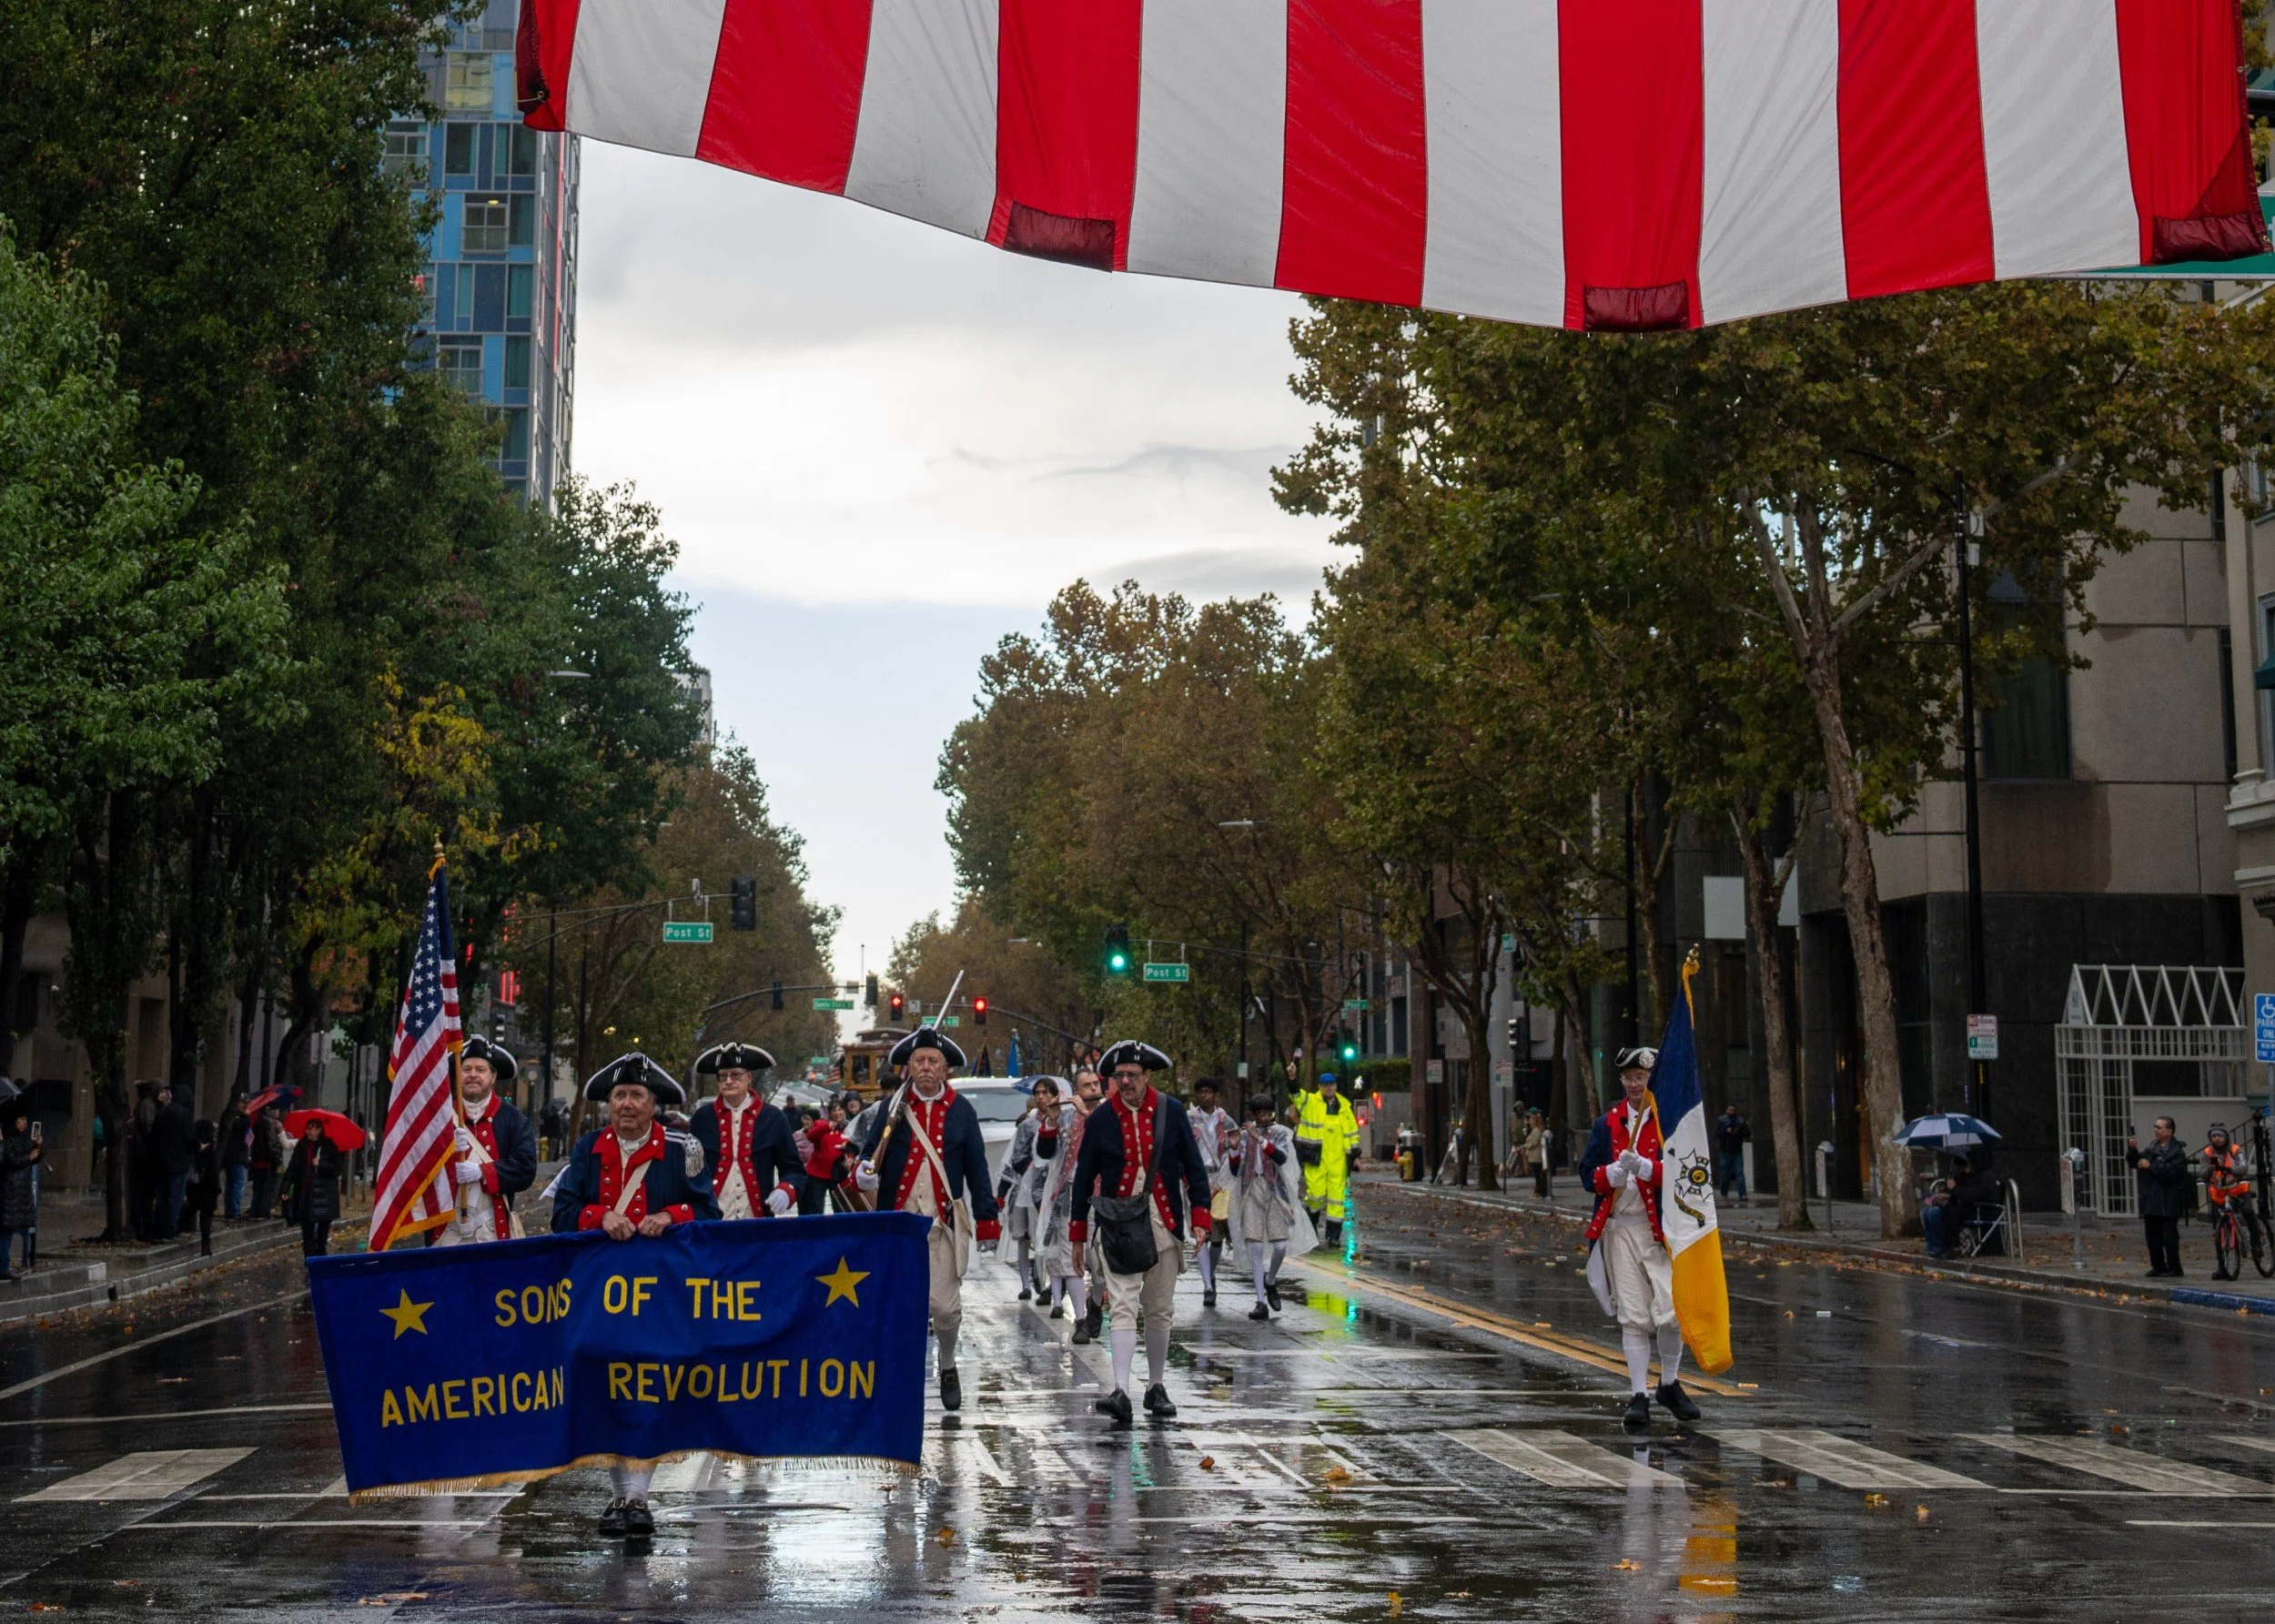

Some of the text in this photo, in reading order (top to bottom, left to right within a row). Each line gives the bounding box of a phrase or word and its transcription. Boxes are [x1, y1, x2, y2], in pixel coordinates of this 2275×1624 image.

[666, 927, 710, 938] Post St
[1147, 967, 1187, 977] Post St
[494, 1275, 762, 1327] SONS OF THE
[380, 1358, 875, 1428] AMERICAN REVOLUTION
